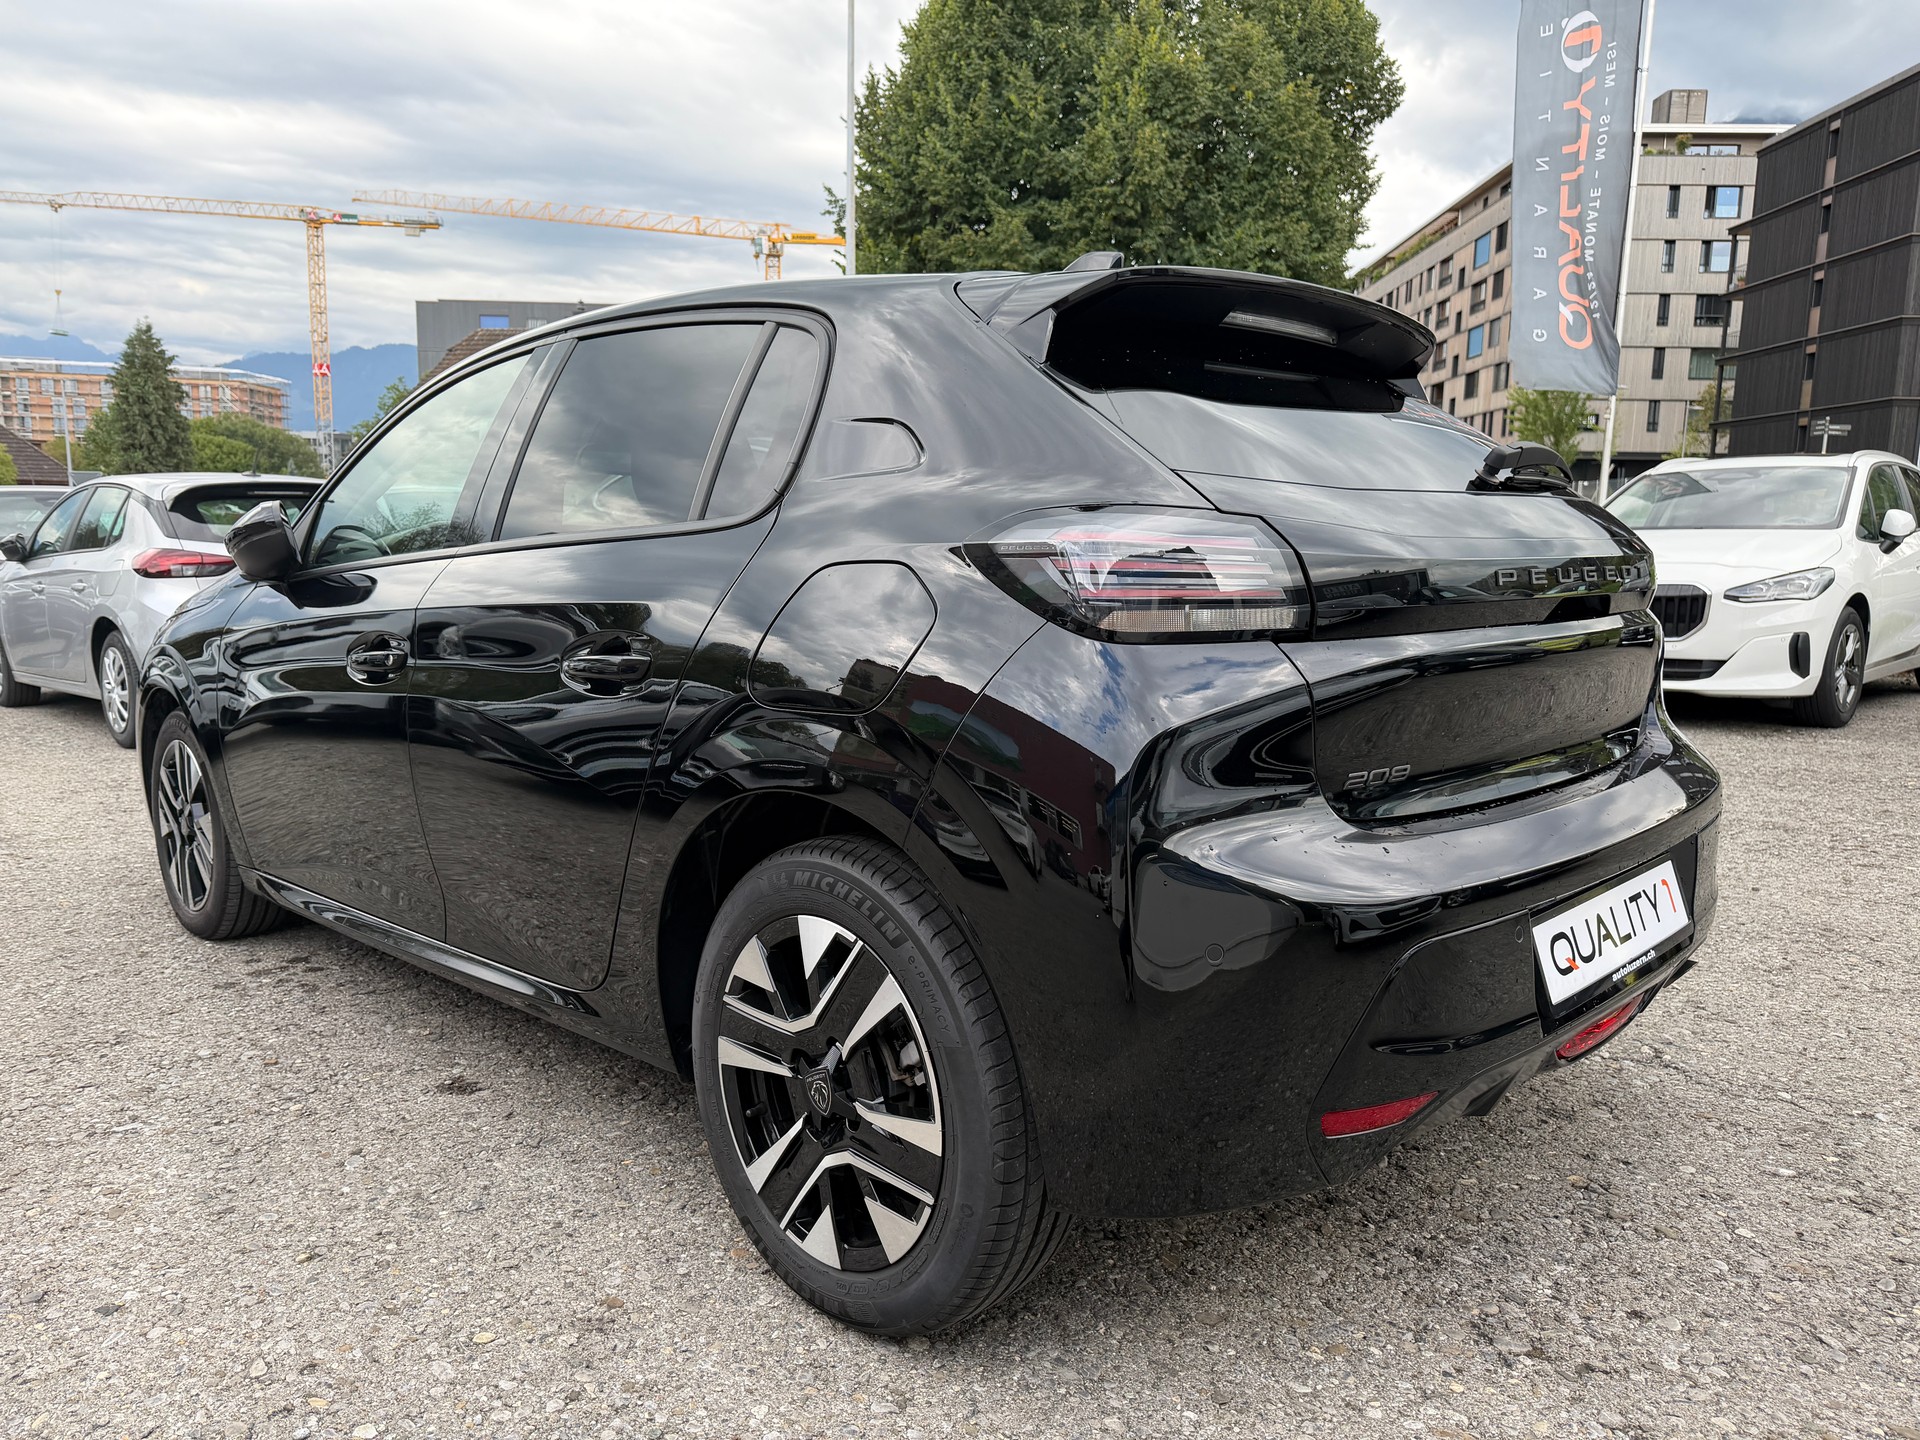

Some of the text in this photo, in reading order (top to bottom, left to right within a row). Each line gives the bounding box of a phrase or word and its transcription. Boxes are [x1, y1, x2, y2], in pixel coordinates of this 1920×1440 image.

[1342, 764, 1411, 790] 208
[793, 871, 901, 941] MICHELIN
[1611, 949, 1656, 982] autoluzern.ch
